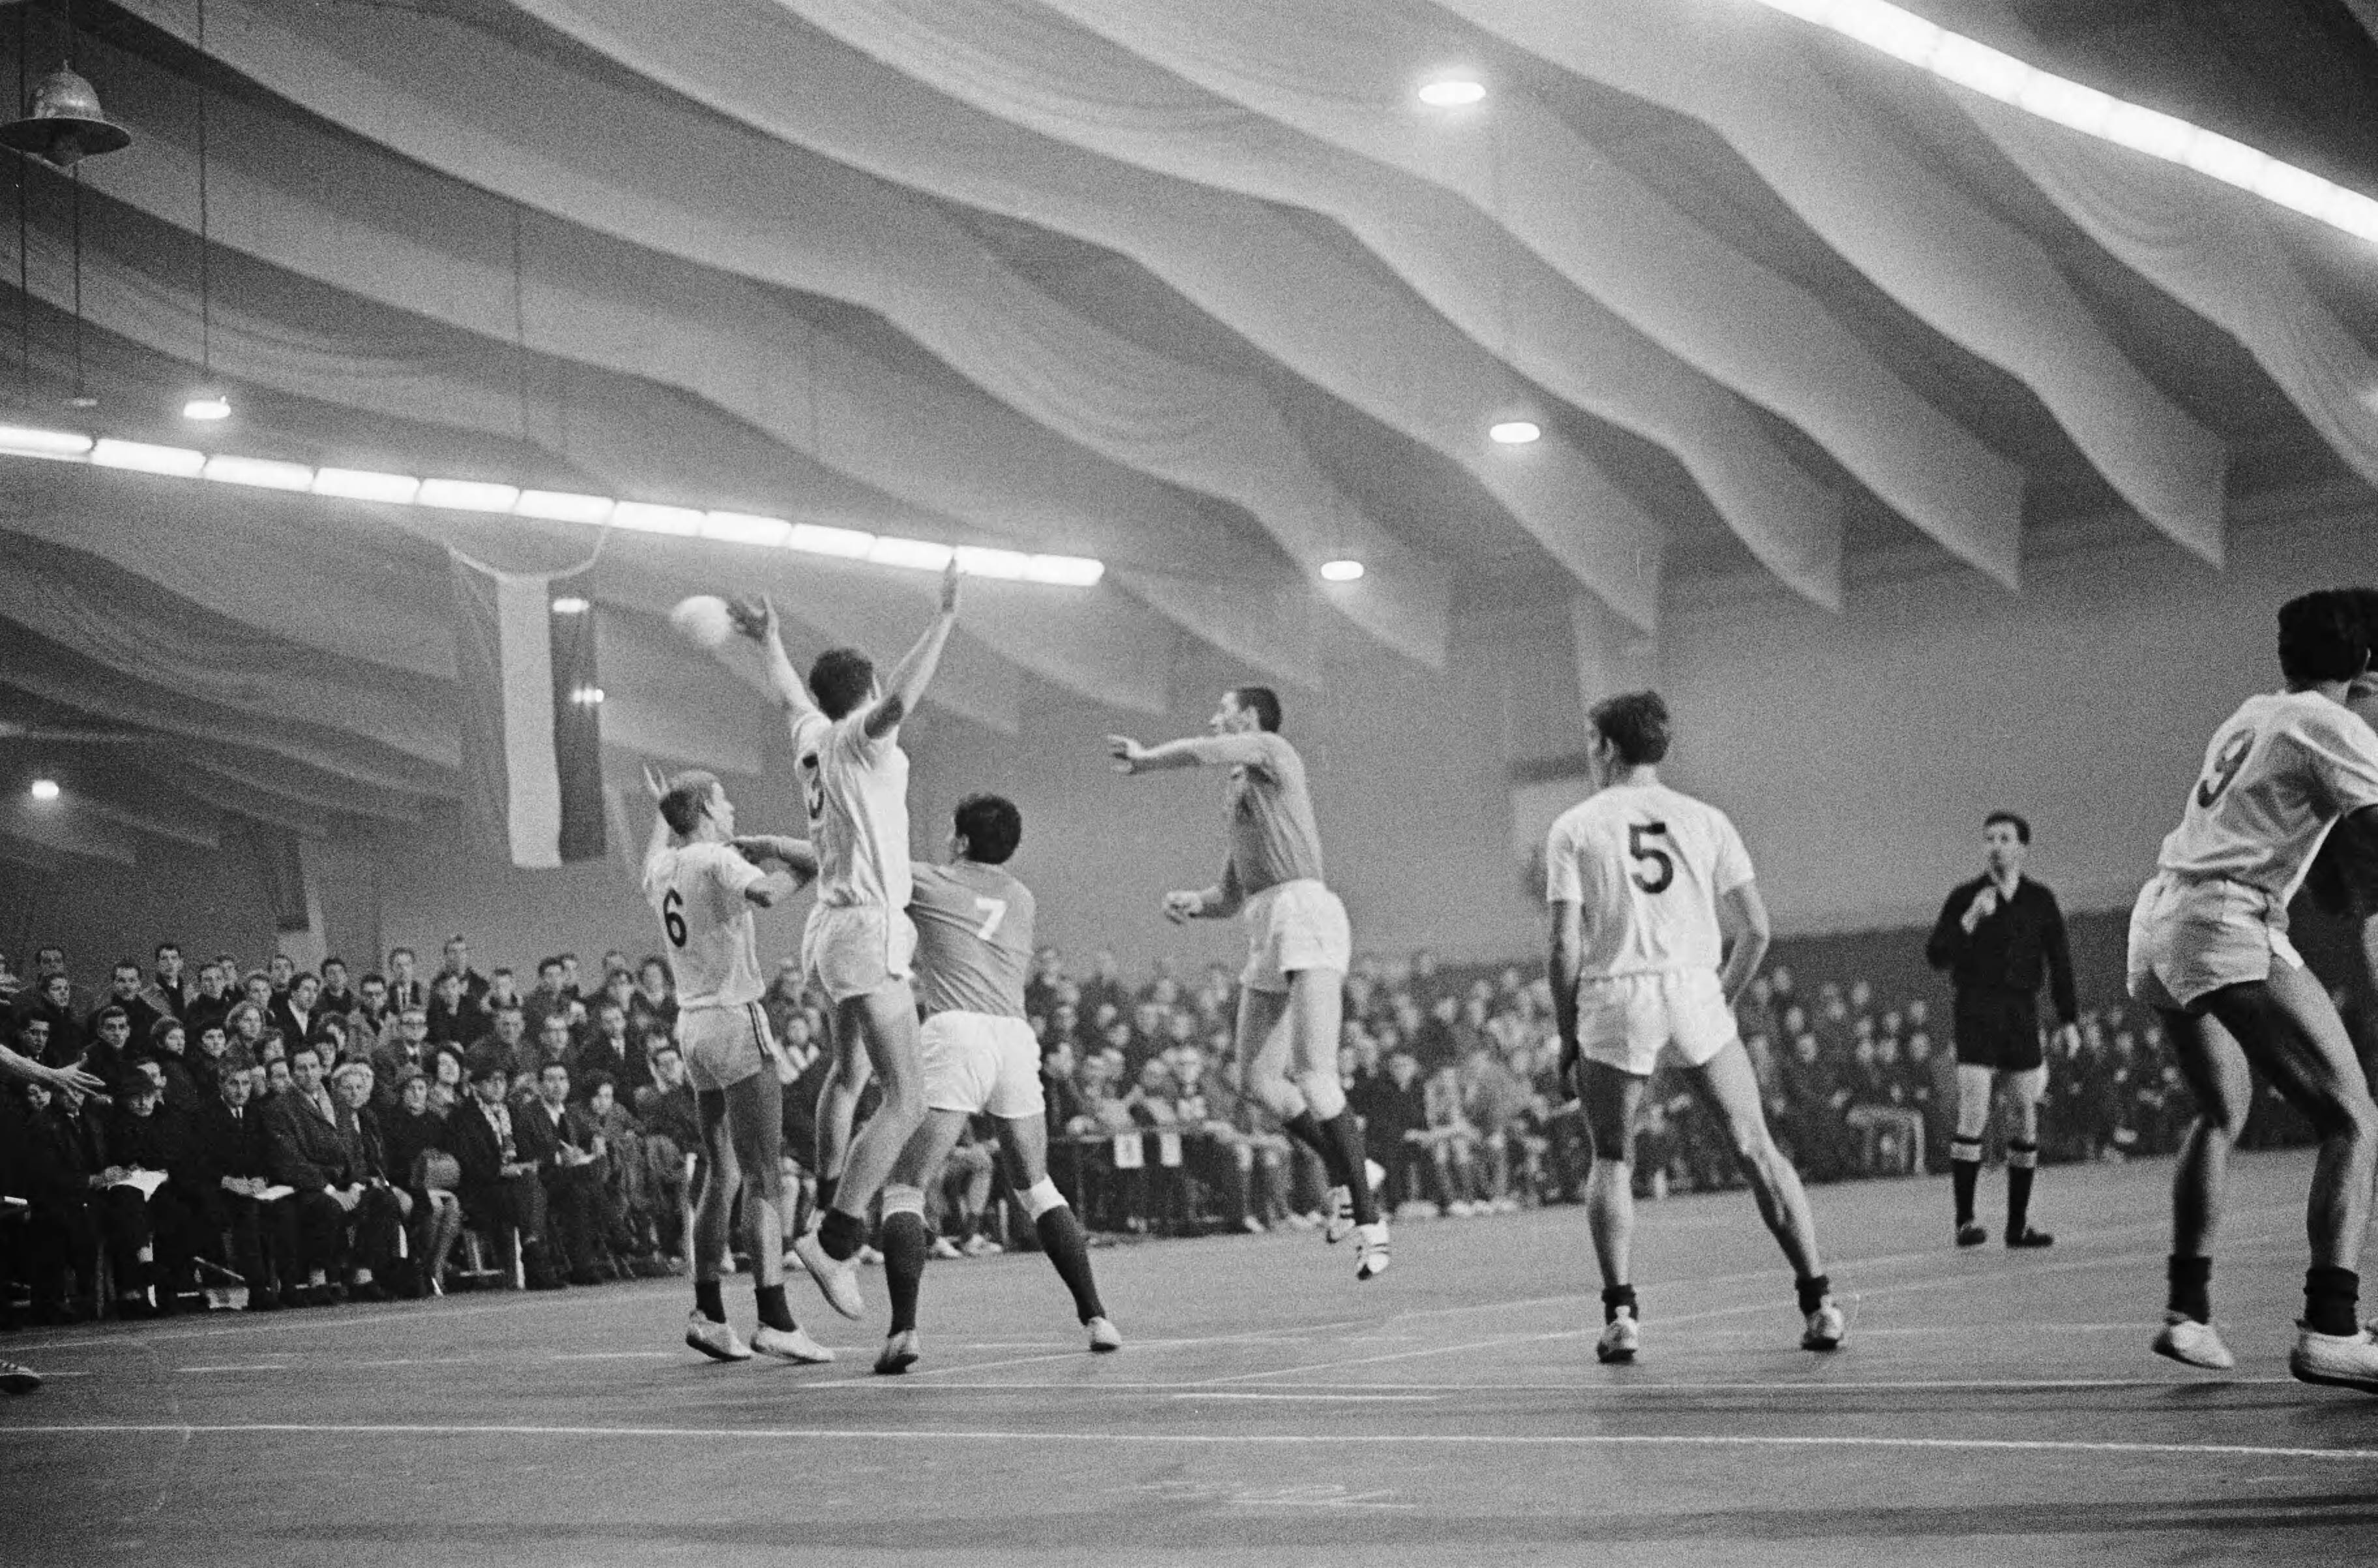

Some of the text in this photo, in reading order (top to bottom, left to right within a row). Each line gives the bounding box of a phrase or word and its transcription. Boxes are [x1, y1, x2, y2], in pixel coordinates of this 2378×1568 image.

[2197, 728, 2255, 808] 9
[1629, 821, 1673, 894] 5
[663, 889, 686, 947] 6
[976, 897, 1007, 940] 7
